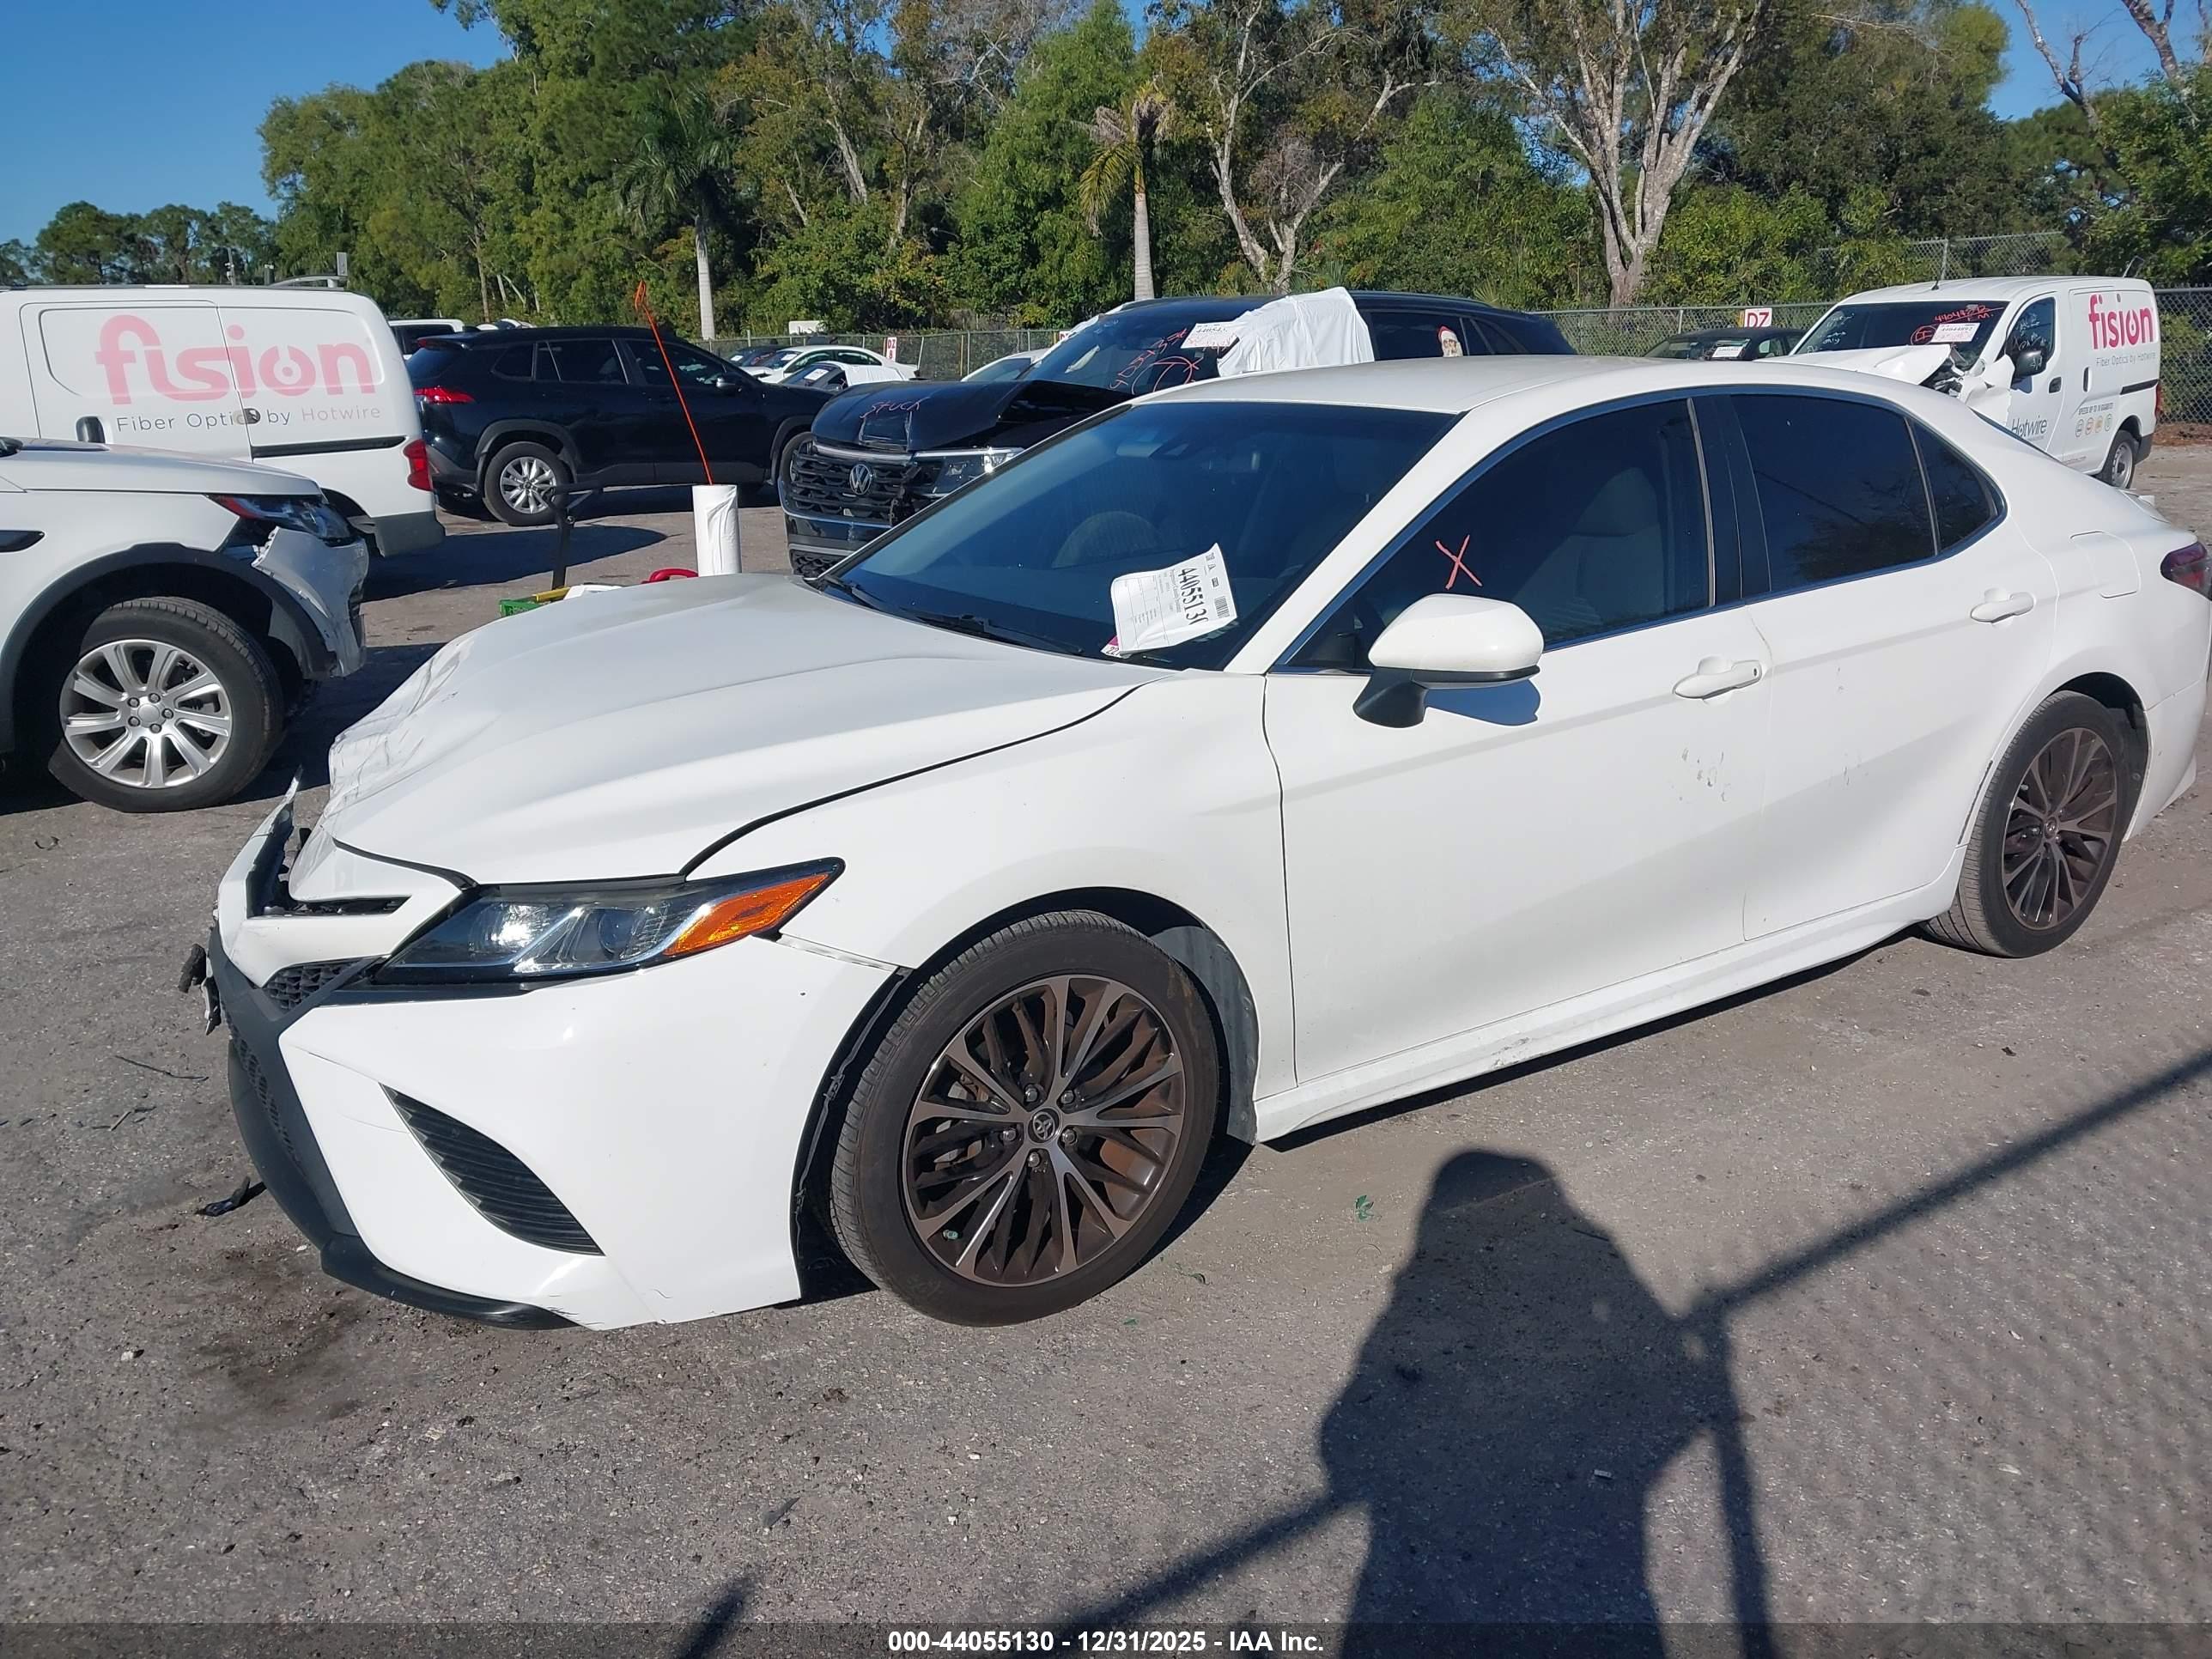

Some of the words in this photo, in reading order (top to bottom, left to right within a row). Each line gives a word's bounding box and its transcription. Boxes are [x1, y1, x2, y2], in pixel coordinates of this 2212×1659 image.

[1747, 312, 1770, 327] DZ
[2088, 294, 2154, 349] fision
[887, 339, 896, 349] DZ
[95, 314, 375, 404] fision
[116, 416, 175, 432] Fiber
[267, 410, 290, 425] by
[301, 404, 380, 422] Hotwire
[2012, 415, 2048, 437] Hotwire
